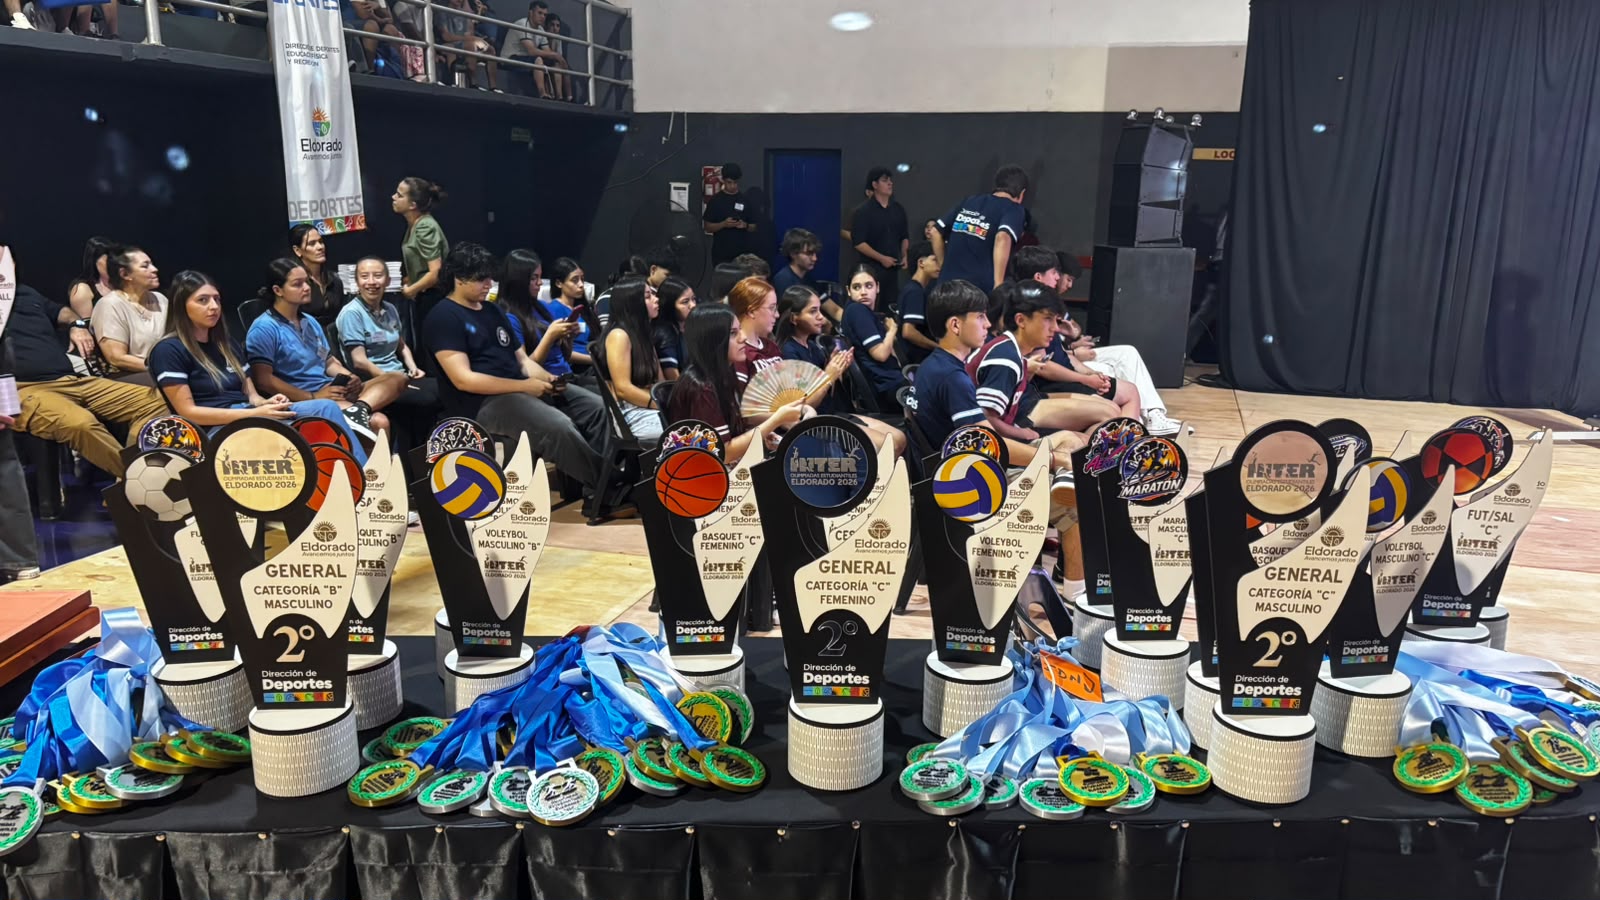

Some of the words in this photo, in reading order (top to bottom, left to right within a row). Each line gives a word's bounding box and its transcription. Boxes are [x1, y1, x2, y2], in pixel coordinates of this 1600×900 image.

[301, 138, 342, 152] Eldorado
[289, 195, 362, 220] DEPORTES
[222, 460, 294, 475] INTER
[790, 458, 856, 472] INTER
[1247, 464, 1315, 478] INTER
[225, 481, 272, 489] ELDORADO
[791, 478, 836, 486] ELDORADO
[1122, 479, 1181, 497] MARATON
[1494, 495, 1531, 504] Eldorado
[369, 512, 405, 520] Eldorado
[510, 514, 547, 523] Eldorado
[1467, 510, 1514, 522] FUT/SAL
[1007, 523, 1045, 532] Eldorado
[1411, 524, 1446, 533] Eldorado
[485, 529, 528, 539] VOLEYBOL
[702, 533, 743, 541] BASQUET
[301, 542, 355, 552] Eldorado
[478, 540, 525, 550] MASCULINO
[700, 542, 744, 550] FEMENINO
[855, 539, 907, 549] Eldorado
[980, 537, 1022, 547] VOLEYBOL
[1385, 542, 1423, 552] VOLEYBOL
[1457, 538, 1497, 549] INTER
[972, 548, 1012, 558] FEMENINO
[1305, 546, 1358, 557] Eldorado
[1376, 554, 1419, 564] MASCULINO
[484, 560, 525, 570] INTER
[703, 563, 743, 572] INTER
[819, 560, 896, 575] GENERAL
[265, 564, 347, 578] GENERAL
[975, 568, 1016, 580] INTER
[1265, 567, 1342, 583] GENERAL
[1377, 575, 1416, 585] INTER
[254, 583, 319, 595] CATEGORÍA
[806, 580, 868, 591] CATEGORÍA
[1249, 587, 1312, 599] CATEGORÍA
[264, 600, 333, 609] MASCULINO
[820, 595, 876, 605] FEMENINO
[1423, 600, 1471, 610] Deportes
[1255, 602, 1321, 614] MASCULINO
[1126, 615, 1172, 624] Deportes
[168, 627, 201, 635] Dirección
[463, 628, 511, 637] Deportes
[676, 626, 725, 635] Deportes
[947, 626, 975, 634] Dirección
[169, 632, 223, 642] Deportes
[946, 632, 995, 644] Deportes
[1343, 645, 1389, 656] Deportes
[262, 670, 303, 678] Dirección
[803, 672, 870, 686] Deportes
[1235, 675, 1276, 683] Dirección
[1278, 675, 1289, 683] de
[262, 679, 332, 692] Deportes
[1234, 684, 1302, 697] Deportes
